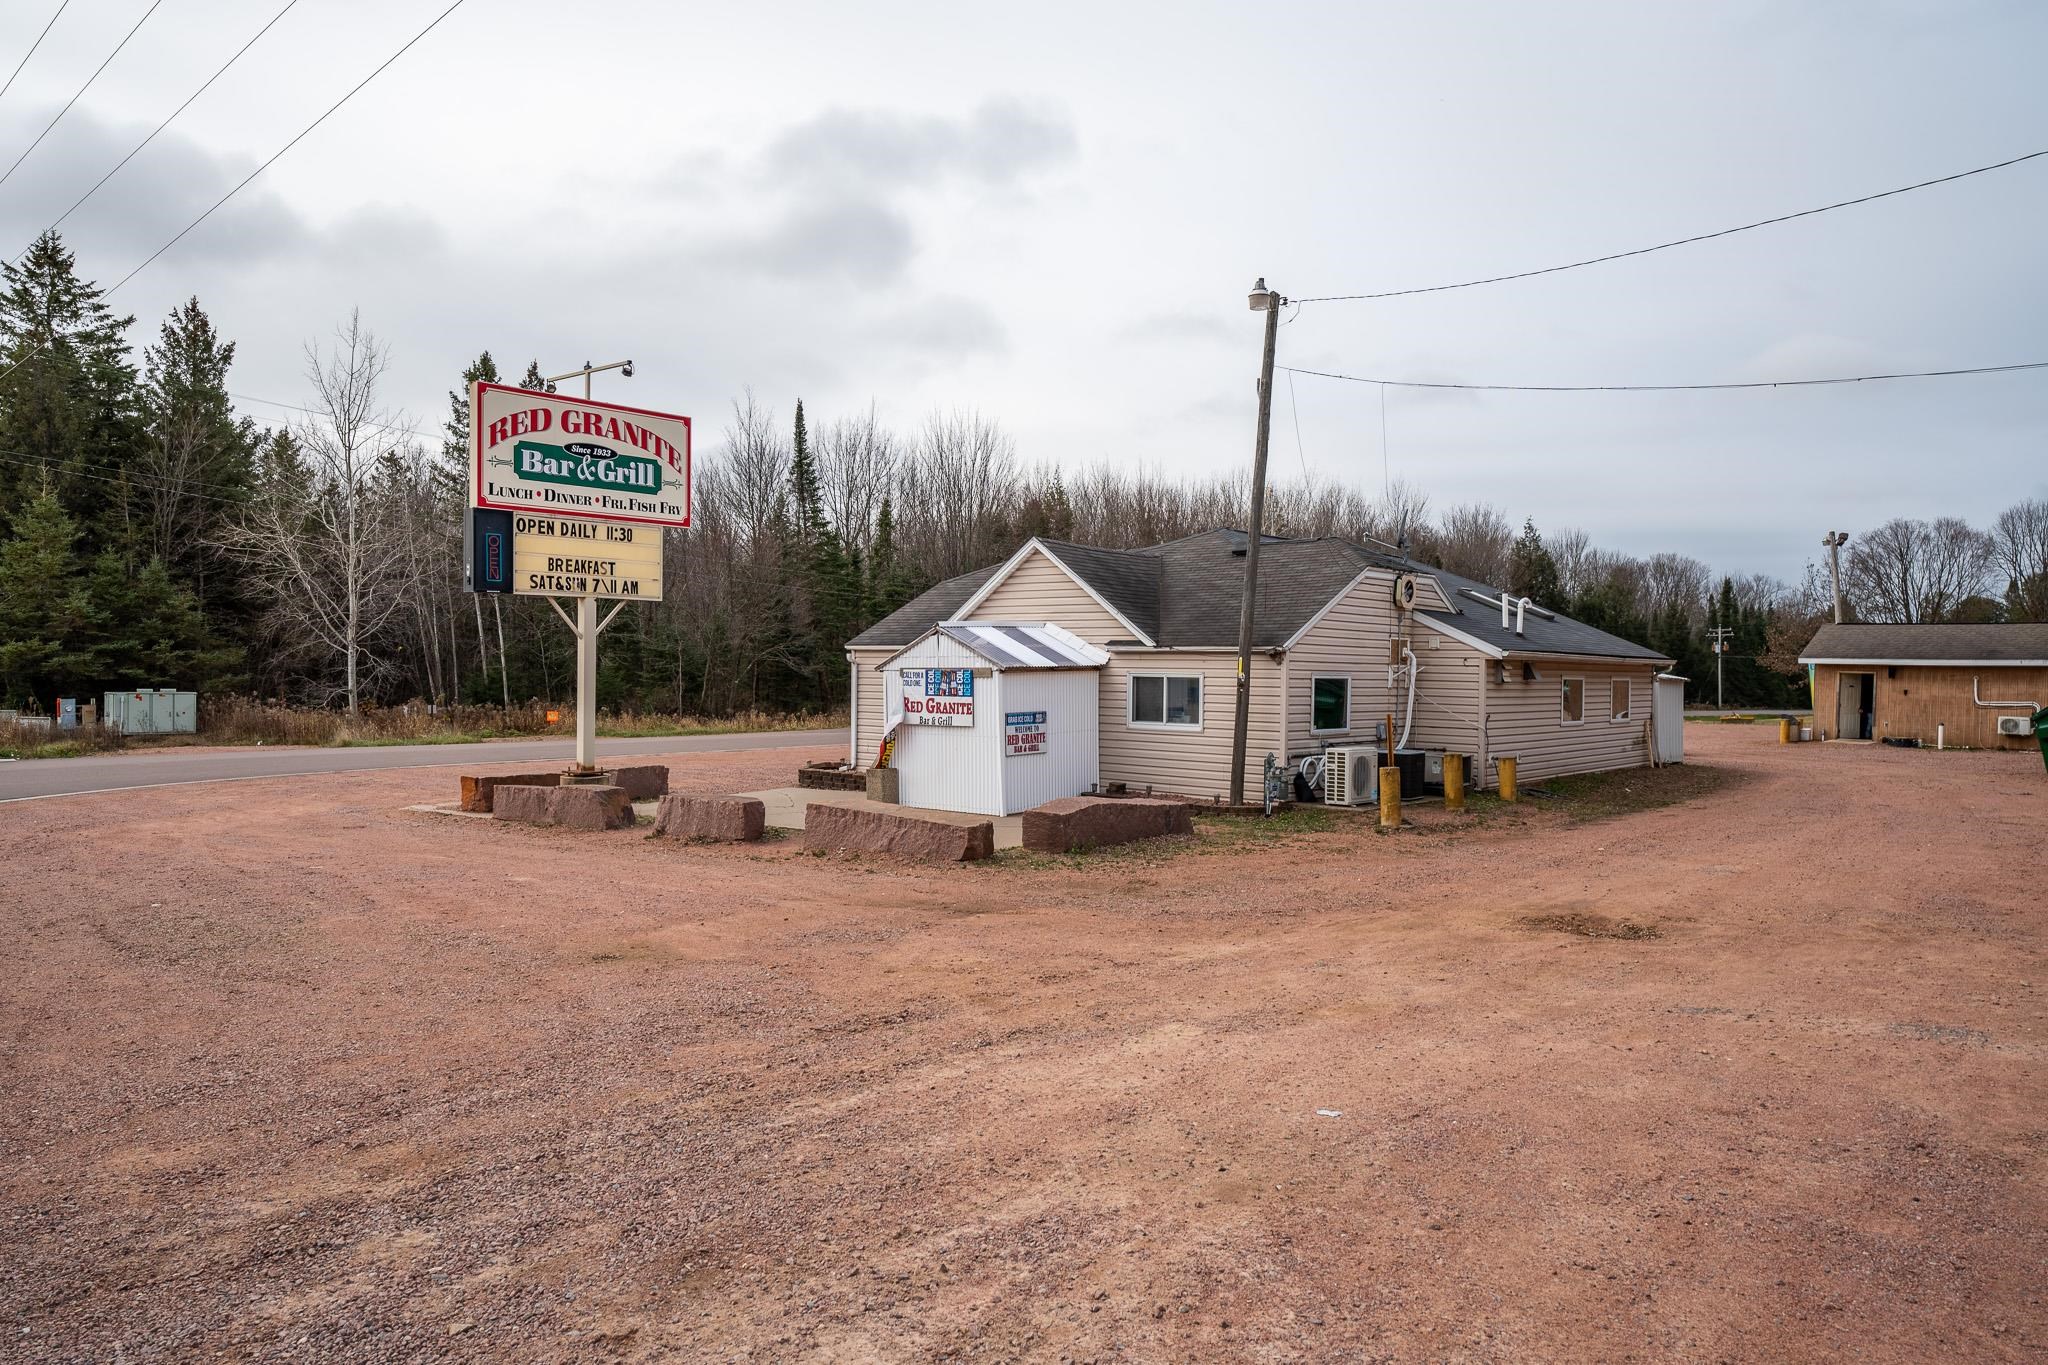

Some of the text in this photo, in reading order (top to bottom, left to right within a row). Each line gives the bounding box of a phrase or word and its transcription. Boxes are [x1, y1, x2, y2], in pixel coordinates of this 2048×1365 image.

[488, 408, 682, 474] RED GRANITE
[571, 444, 612, 457] Since 1933
[488, 482, 682, 516] LUNCH DINNER FRI. FISH FRY
[516, 518, 633, 542] OPEN DAILY 11:30
[488, 536, 500, 580] OPEN
[548, 557, 616, 576] BREAKFAST
[622, 580, 639, 595] AM
[904, 697, 972, 715] RED GRANITE
[920, 716, 930, 725] Bar
[938, 716, 952, 726] Grill
[1008, 732, 1046, 745] RED GRANITE
